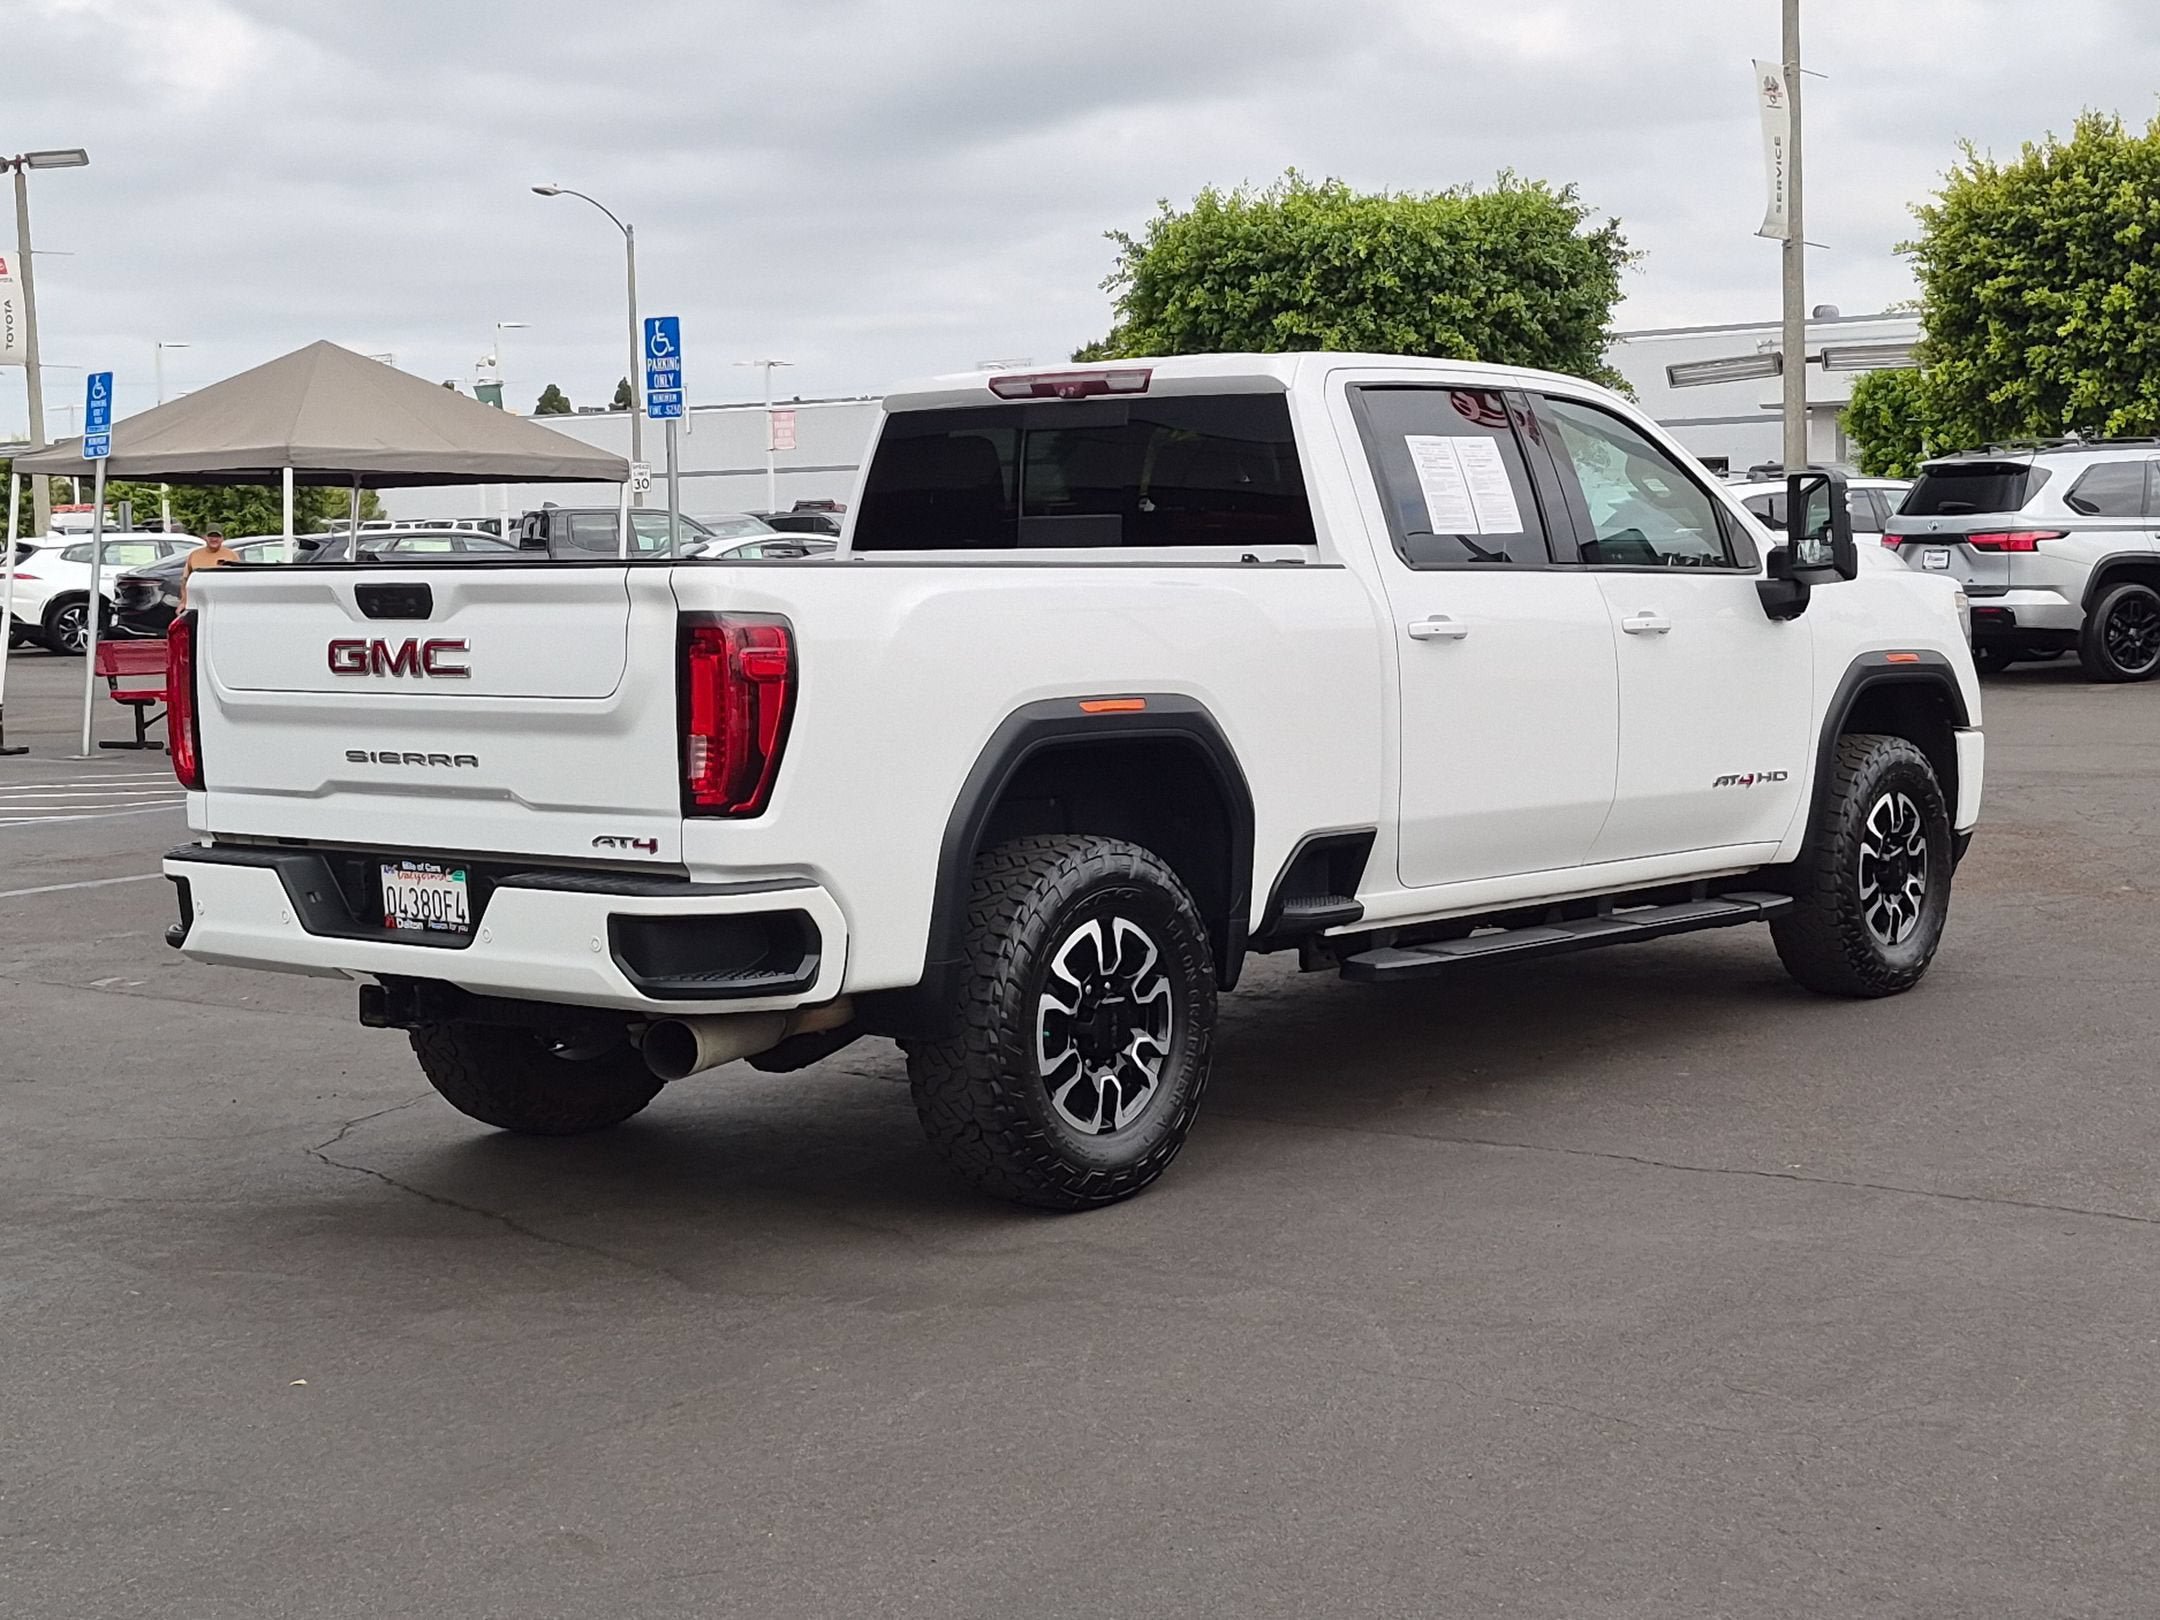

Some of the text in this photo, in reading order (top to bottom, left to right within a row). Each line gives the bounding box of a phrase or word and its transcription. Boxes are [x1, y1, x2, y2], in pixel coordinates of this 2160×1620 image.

[1774, 136, 1782, 214] SERVICE
[4, 299, 14, 350] TOYOTA
[647, 356, 680, 372] PARKING
[653, 373, 674, 388] ONLY
[634, 478, 650, 490] 30
[328, 638, 471, 678] GMC
[345, 750, 479, 768] SIERRA
[592, 835, 658, 855] AT4
[386, 886, 466, 923] 04380F4
